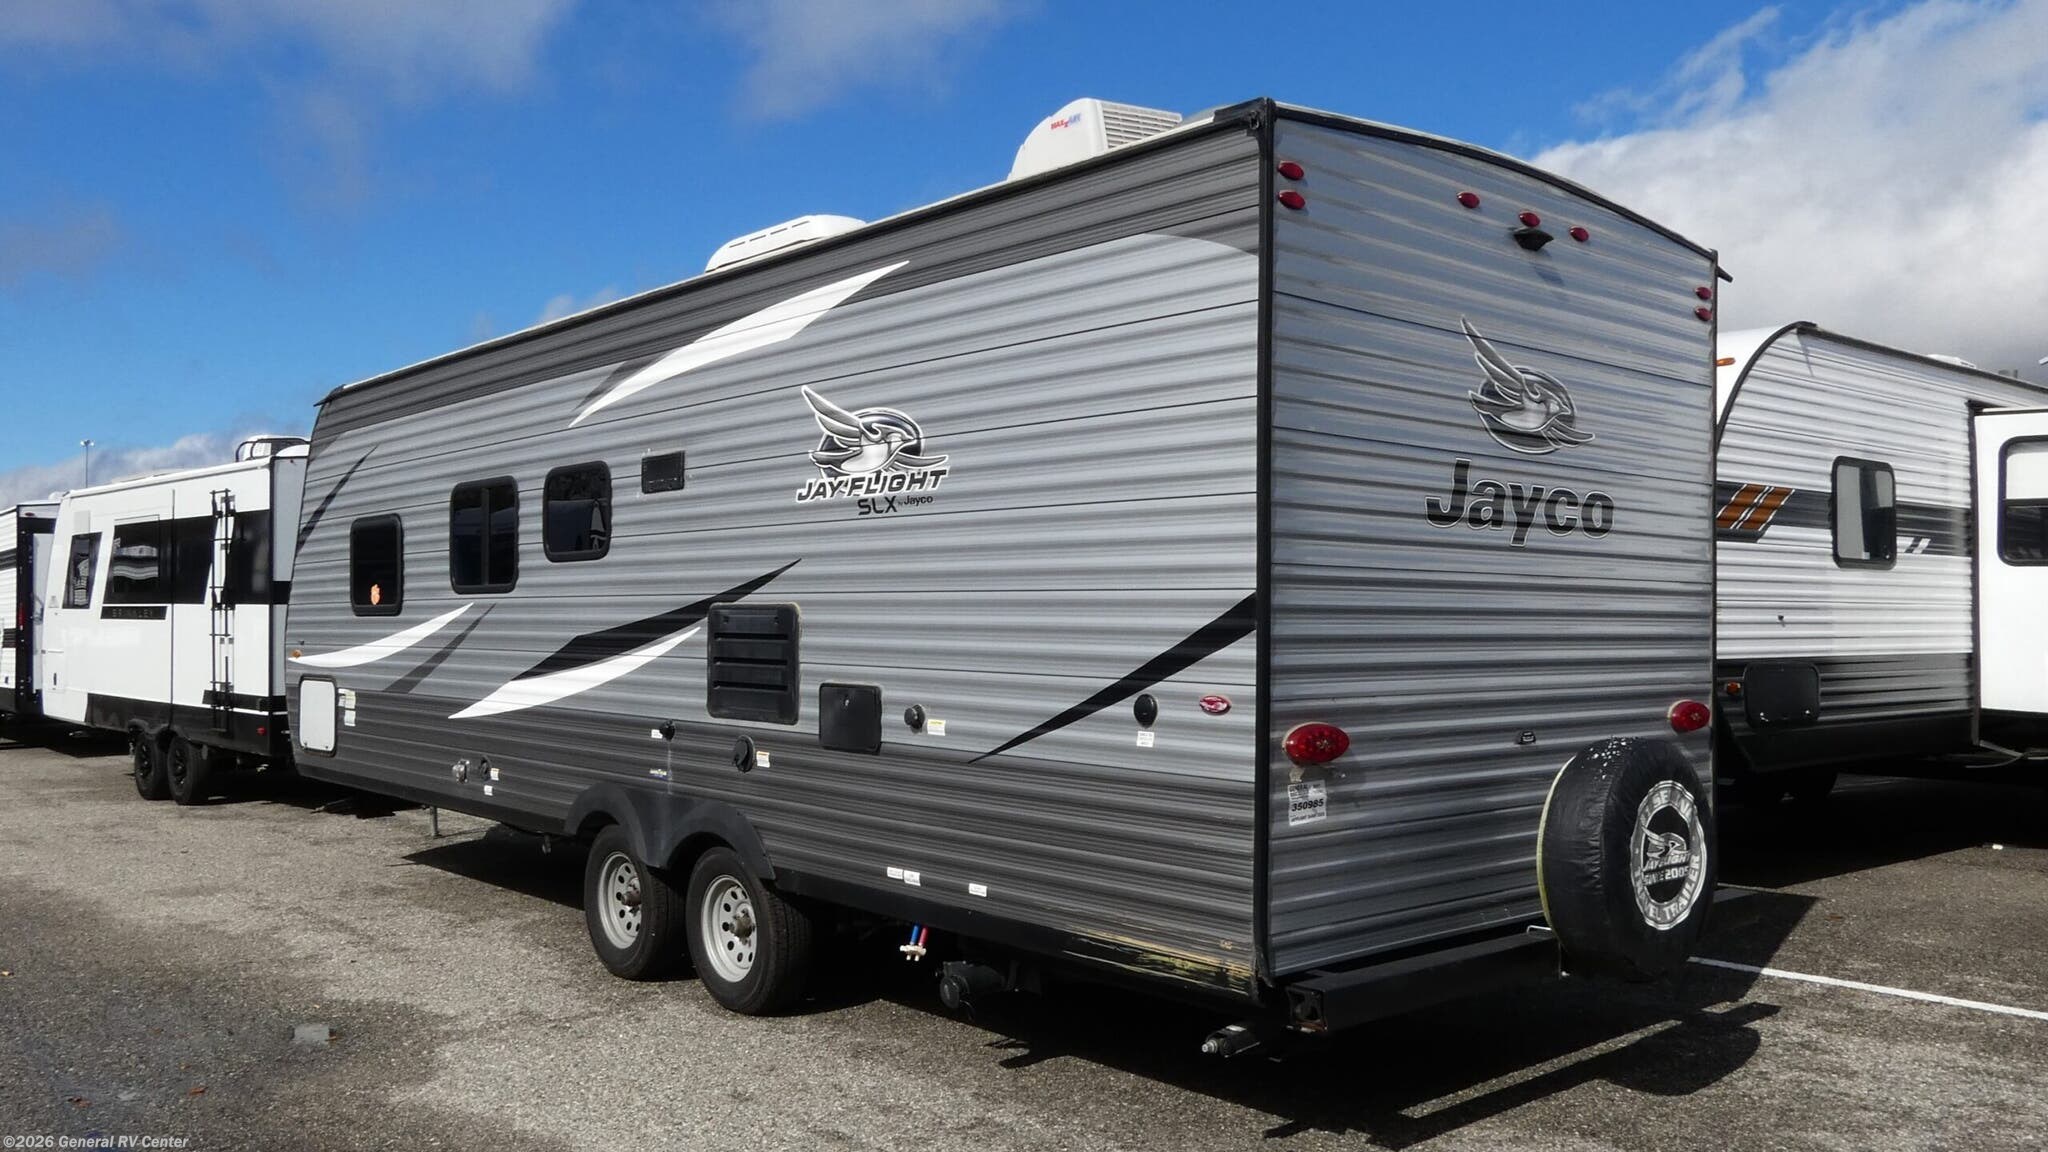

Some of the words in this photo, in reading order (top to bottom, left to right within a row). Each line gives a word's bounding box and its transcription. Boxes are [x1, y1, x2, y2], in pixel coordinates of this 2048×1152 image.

[796, 477, 844, 502] JAY
[846, 467, 950, 497] FLIGHT
[1425, 457, 1615, 547] Jayco
[857, 496, 898, 515] SLX
[904, 495, 934, 507] Jayco
[1291, 799, 1324, 812] 350985
[1662, 855, 1701, 920] TRAILER
